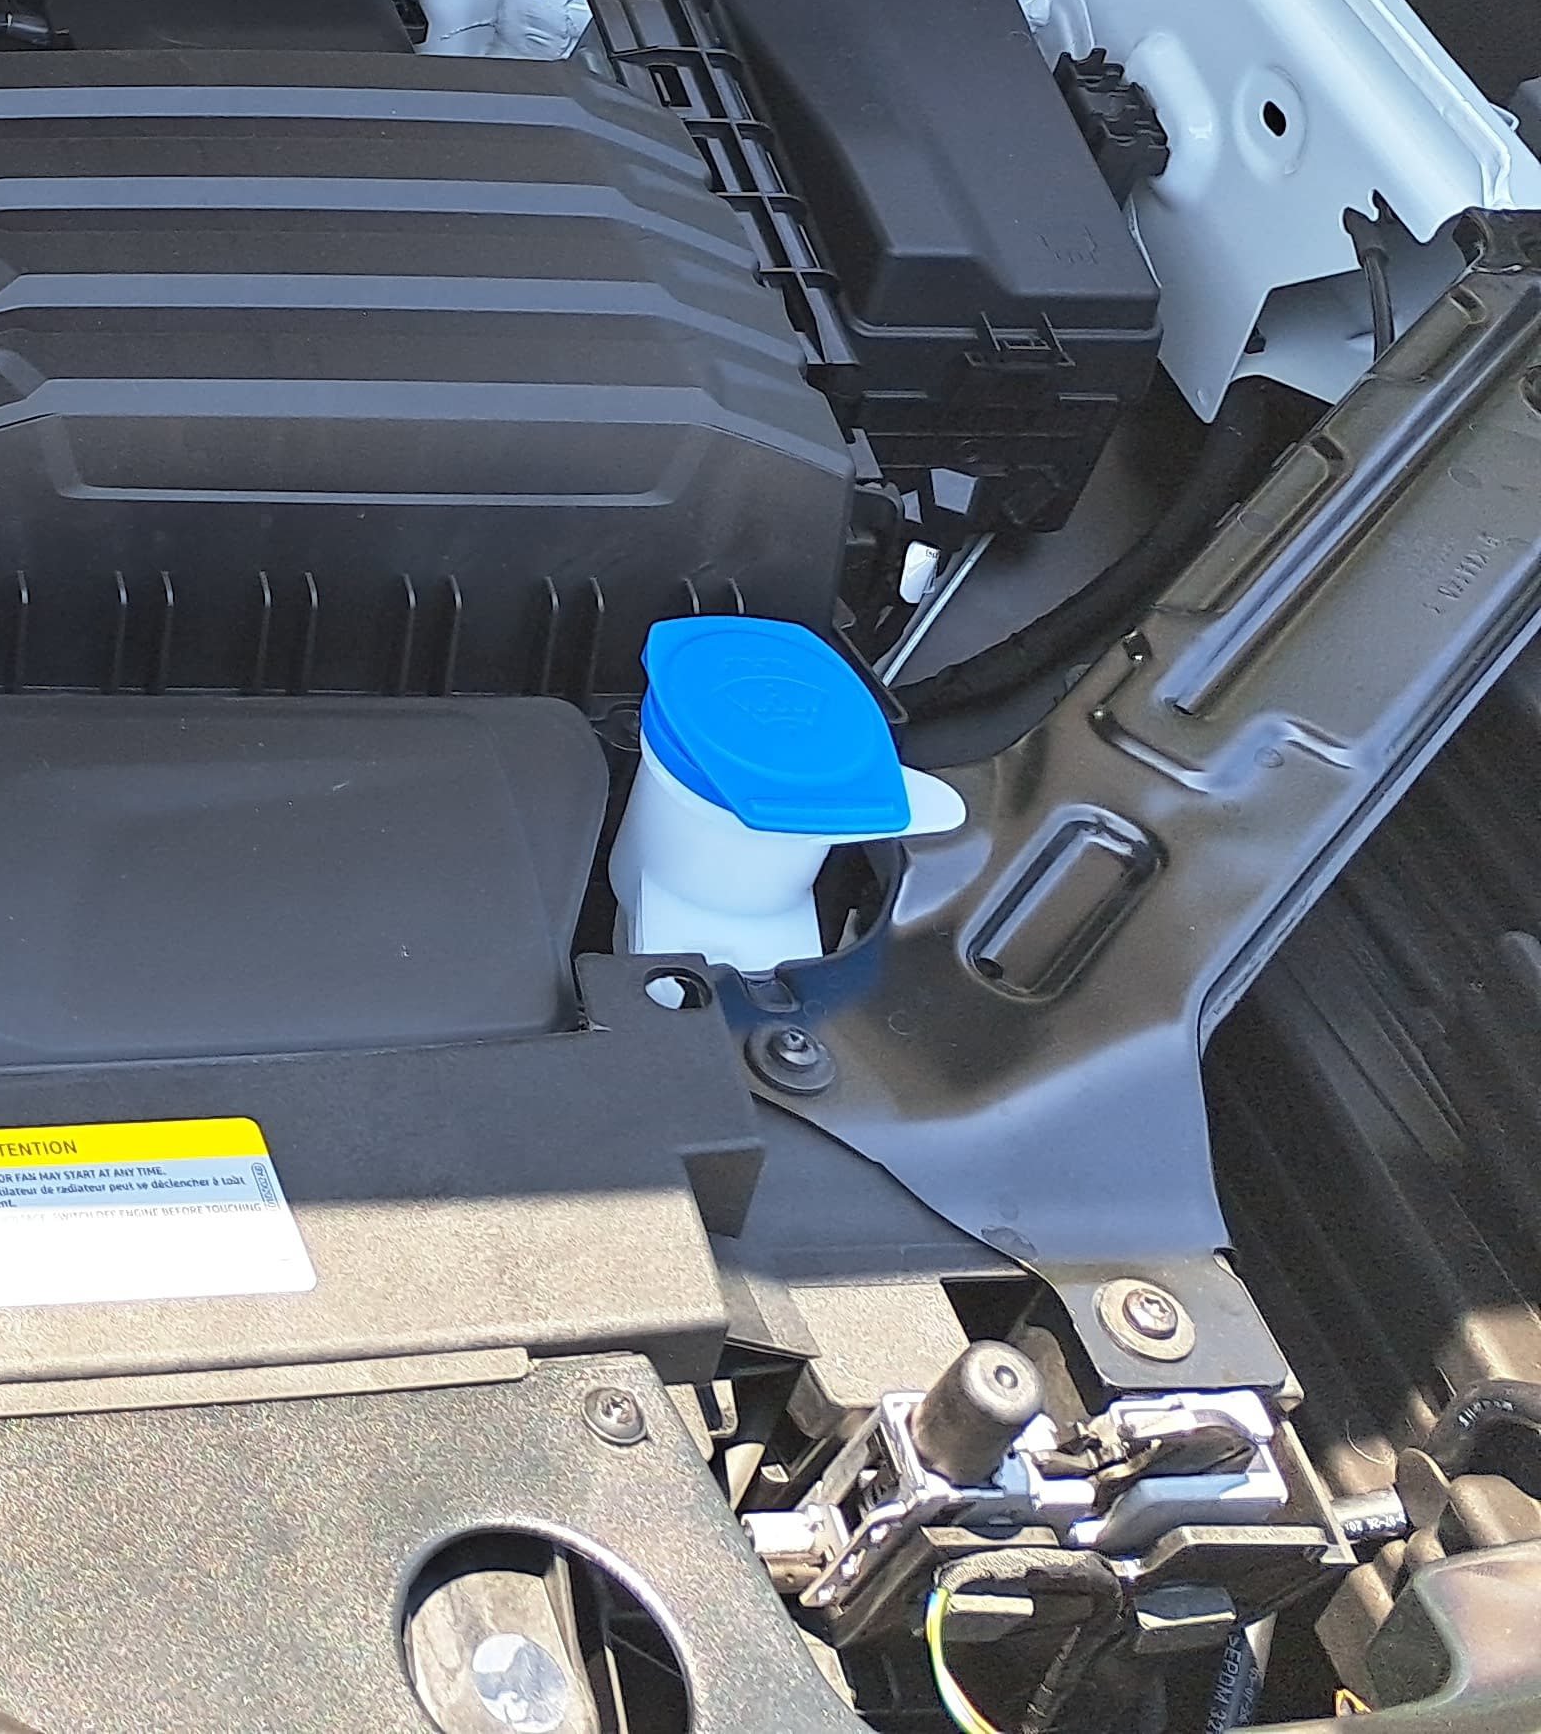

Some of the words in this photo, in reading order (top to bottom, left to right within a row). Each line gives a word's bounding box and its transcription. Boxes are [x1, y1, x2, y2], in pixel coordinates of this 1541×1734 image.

[15, 1171, 37, 1183] FAN
[39, 1170, 61, 1181] MAY
[63, 1168, 96, 1180] START
[98, 1168, 111, 1178] AT
[113, 1166, 134, 1177] ANY
[136, 1166, 167, 1176] TIME.
[40, 1184, 54, 1195] de
[56, 1183, 106, 1194] radiateur
[109, 1181, 134, 1193] peut
[204, 1202, 262, 1214] TOUCHING
